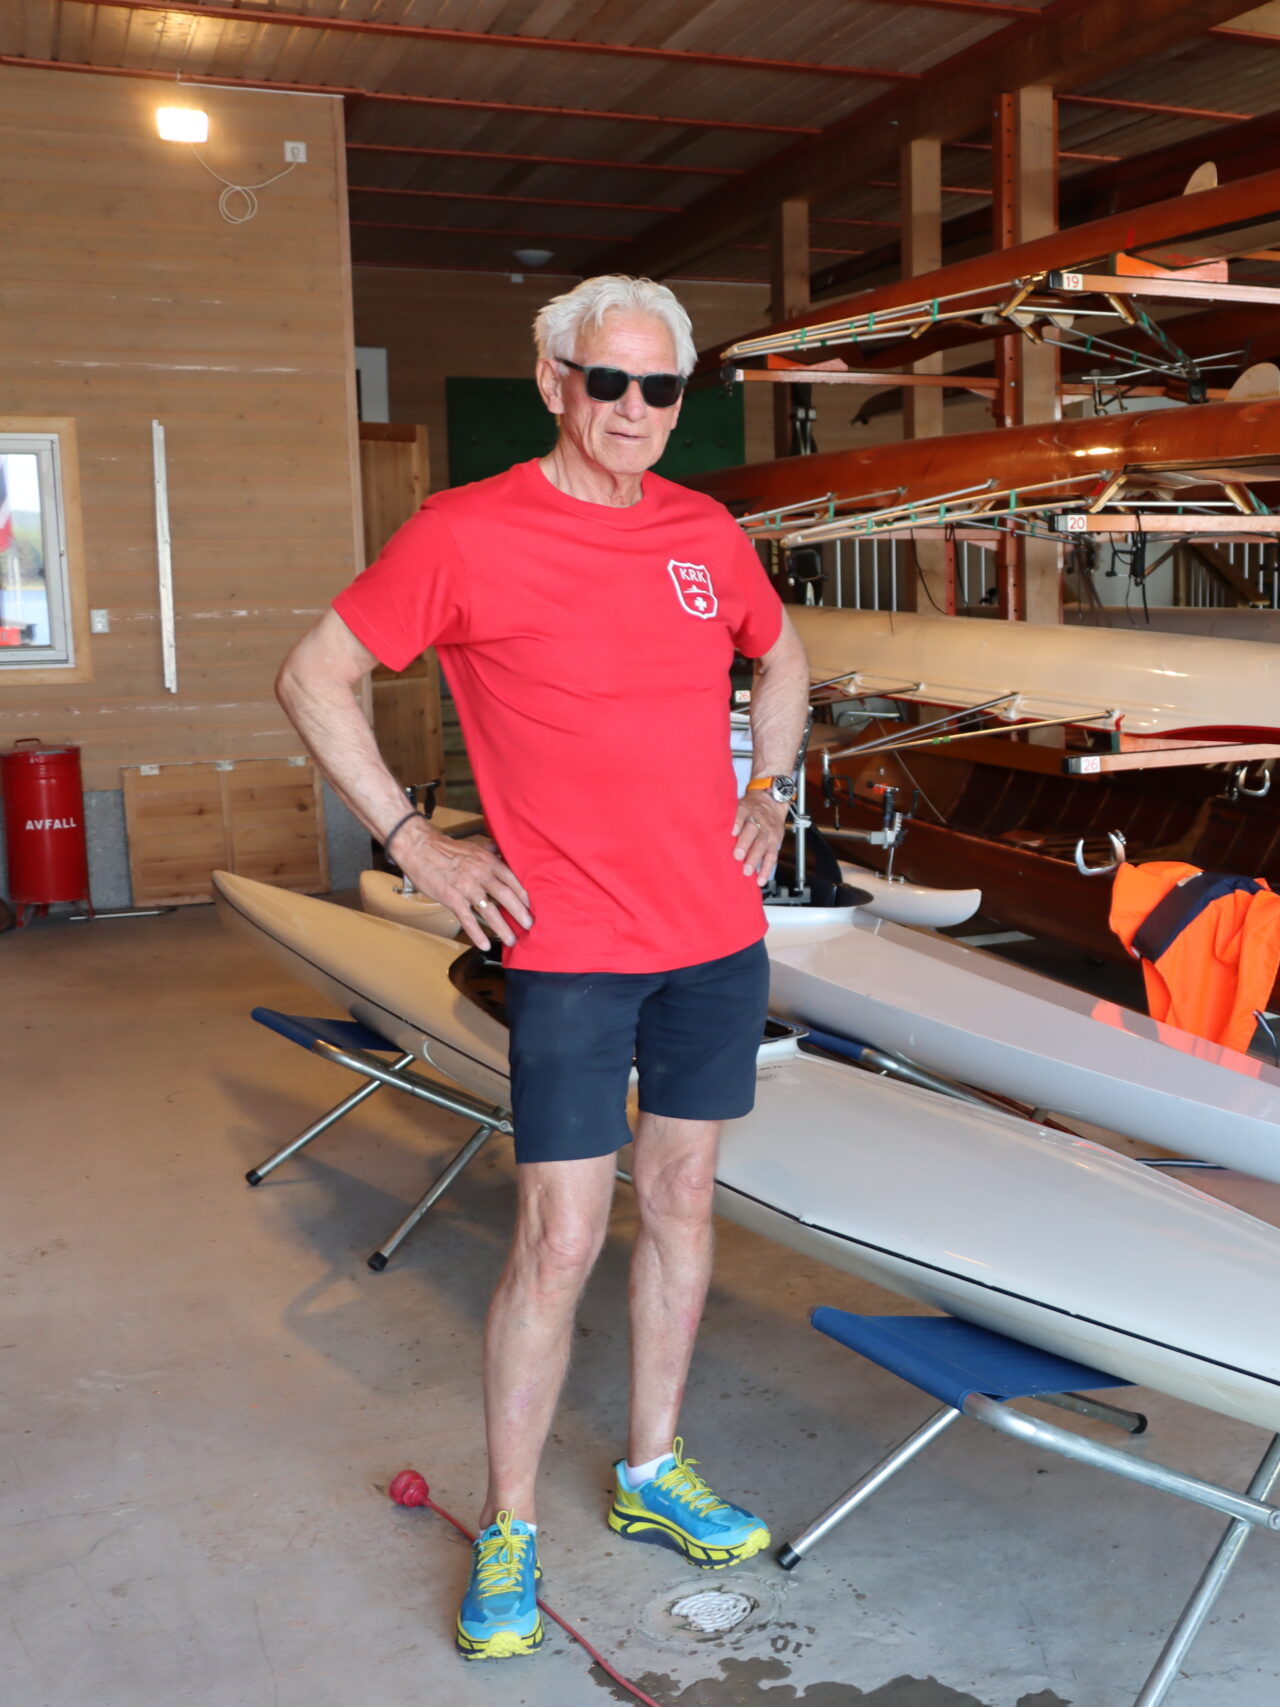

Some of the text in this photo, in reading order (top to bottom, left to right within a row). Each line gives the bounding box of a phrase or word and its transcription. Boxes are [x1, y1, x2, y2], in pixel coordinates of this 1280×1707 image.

[1066, 275, 1080, 288] 19
[1069, 516, 1086, 530] 20
[679, 567, 707, 583] KRK
[1083, 757, 1099, 771] 26
[25, 817, 77, 830] AVFALL
